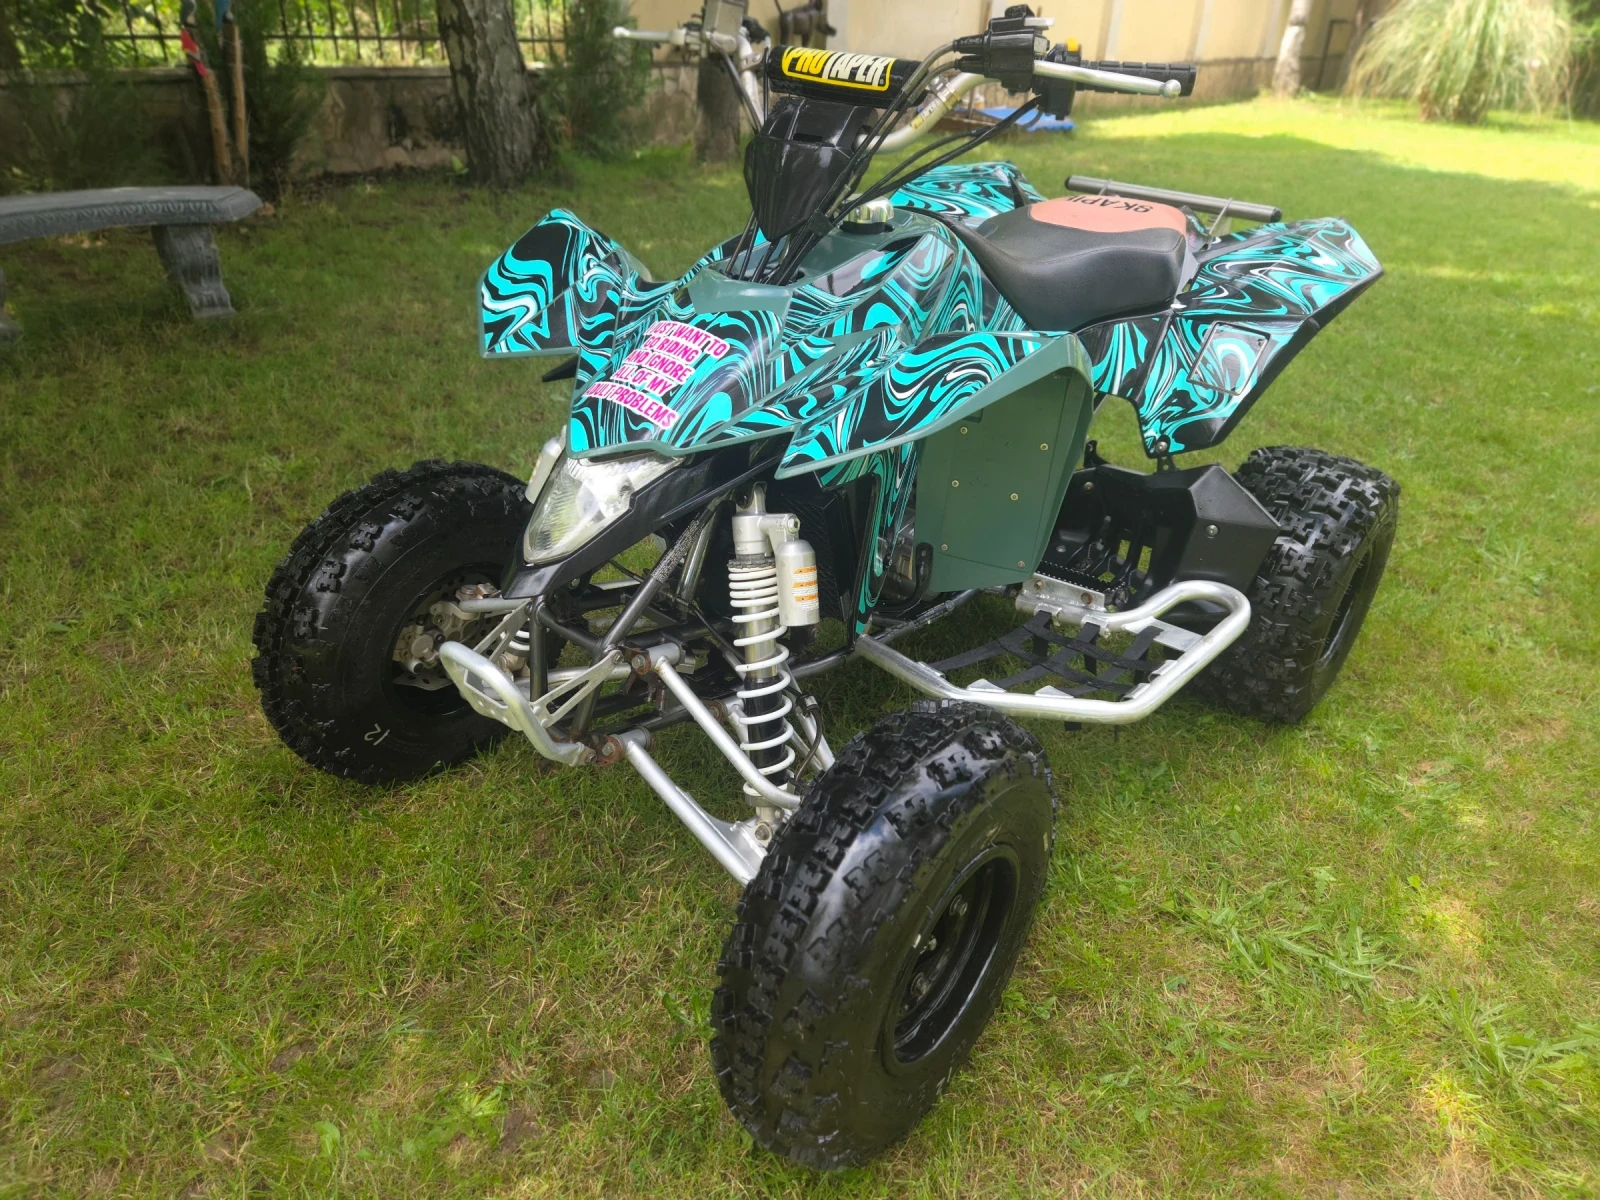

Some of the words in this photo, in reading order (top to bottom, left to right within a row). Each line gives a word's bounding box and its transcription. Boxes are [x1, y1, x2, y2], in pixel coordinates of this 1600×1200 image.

[643, 336, 658, 348] GO
[659, 337, 700, 363] RIDING
[673, 325, 708, 347] WANT
[706, 338, 727, 357] TO
[615, 366, 635, 379] ALL
[632, 370, 652, 384] OF
[647, 378, 673, 395] MY
[627, 351, 646, 365] AND
[646, 353, 692, 383] IGNORE
[612, 386, 677, 428] PROBLEMS
